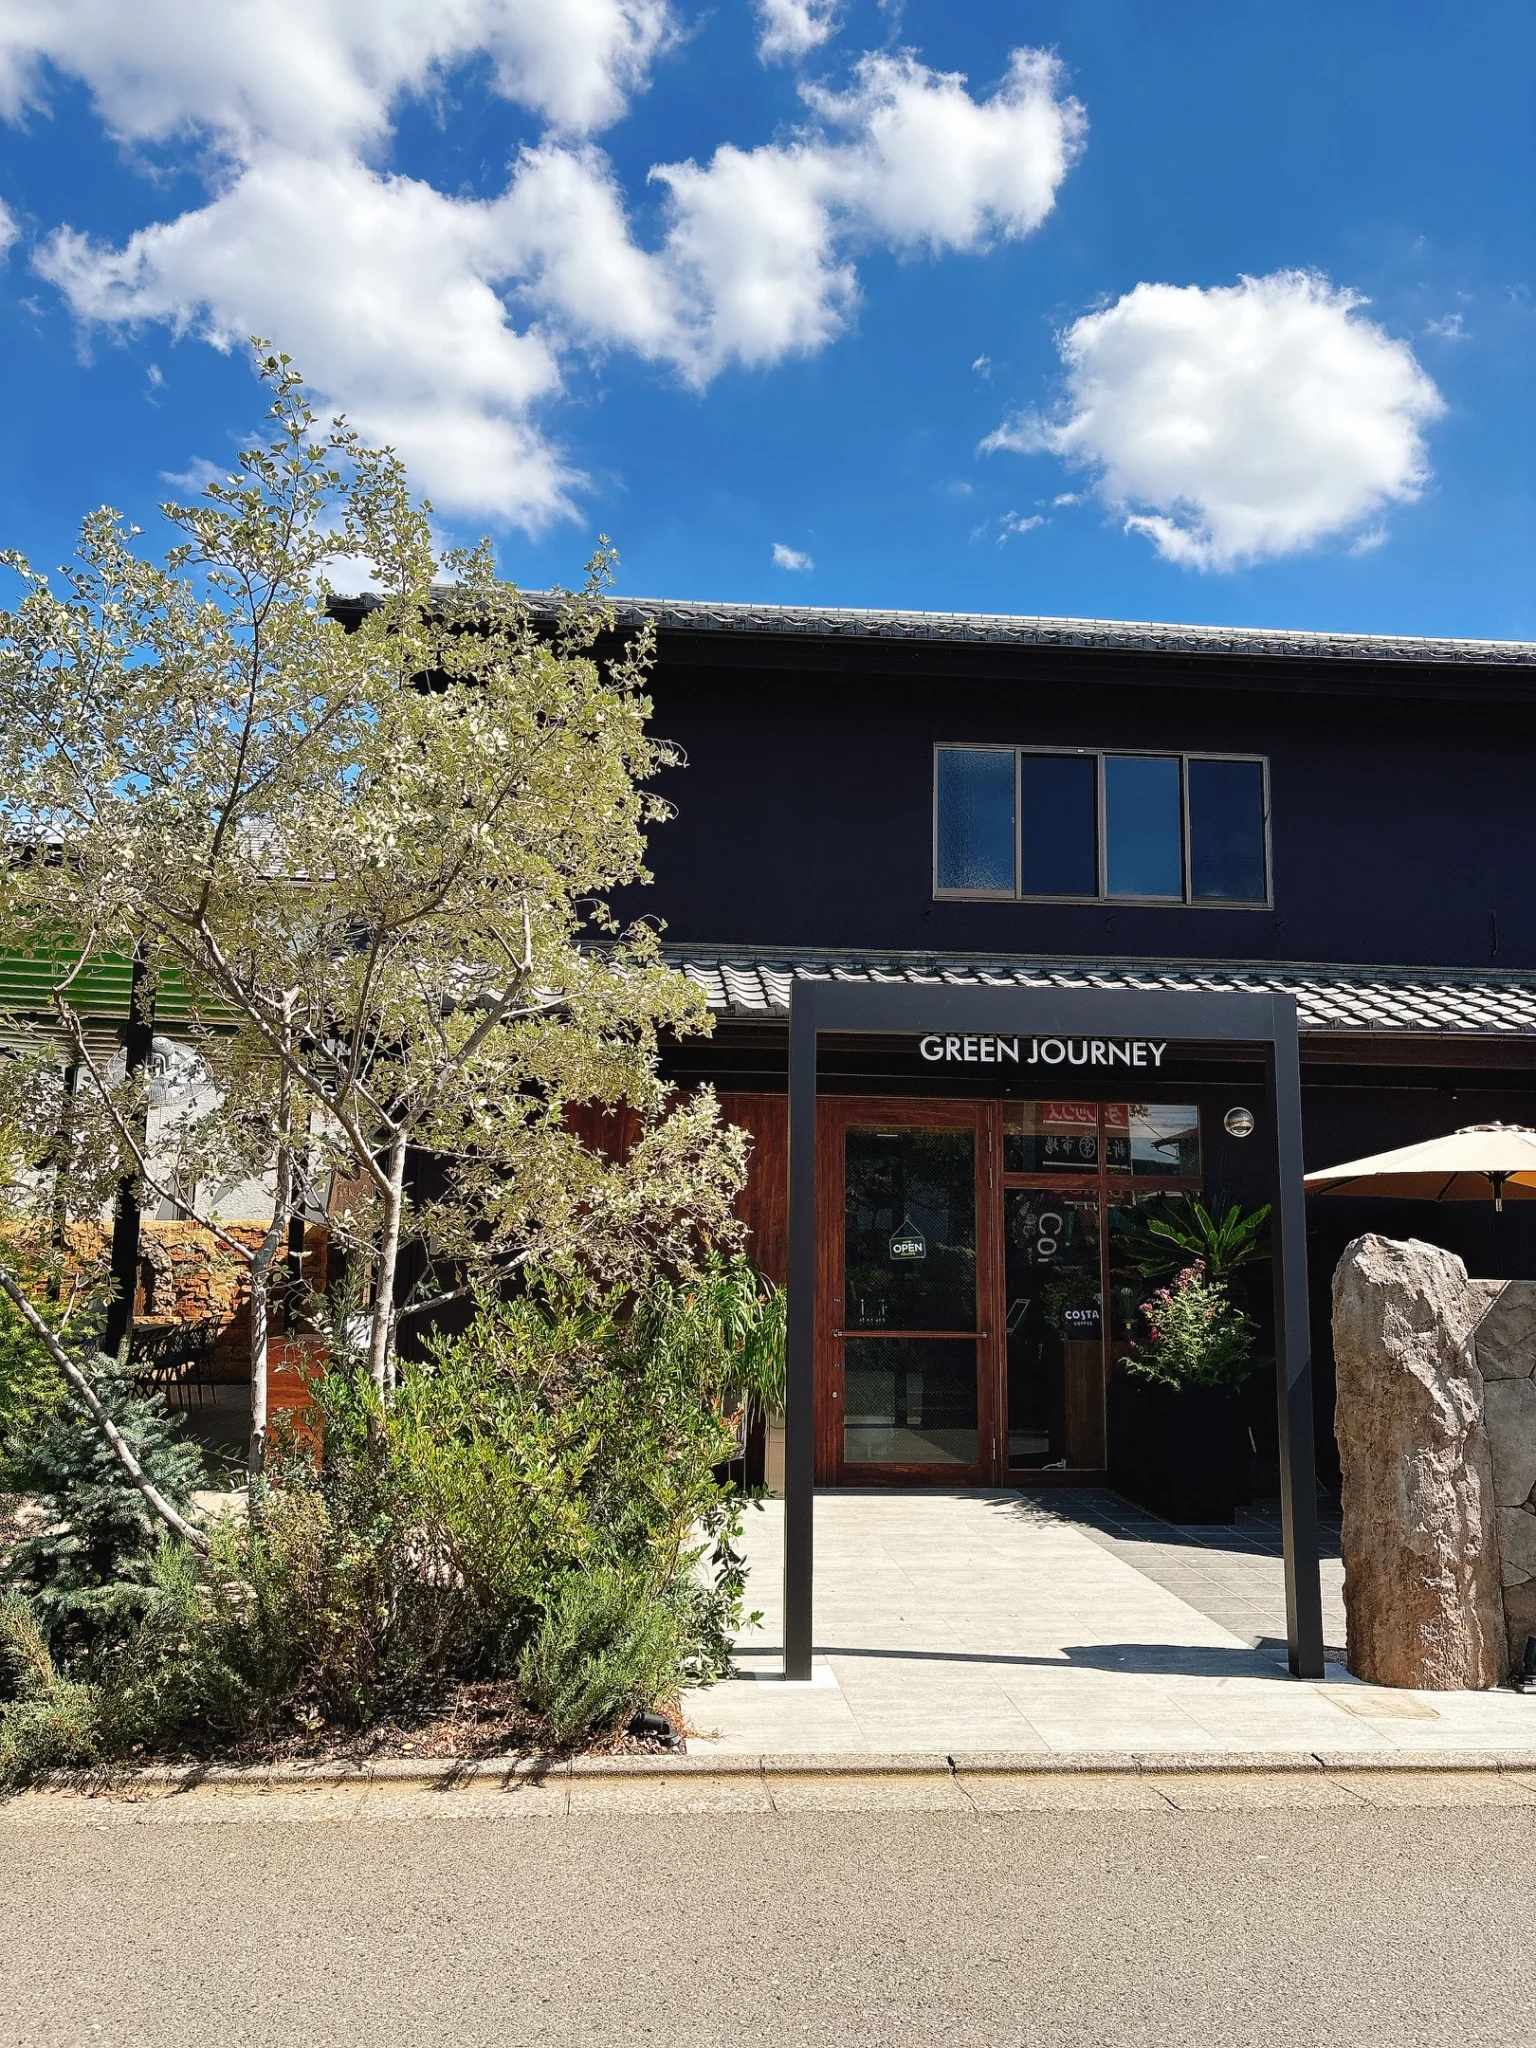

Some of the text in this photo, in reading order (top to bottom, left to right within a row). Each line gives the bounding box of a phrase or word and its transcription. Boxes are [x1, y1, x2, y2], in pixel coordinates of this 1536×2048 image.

[919, 1035, 1167, 1067] GREEN JOURNEY
[893, 1242, 923, 1253] OPEN
[1065, 1309, 1100, 1321] COSTA
